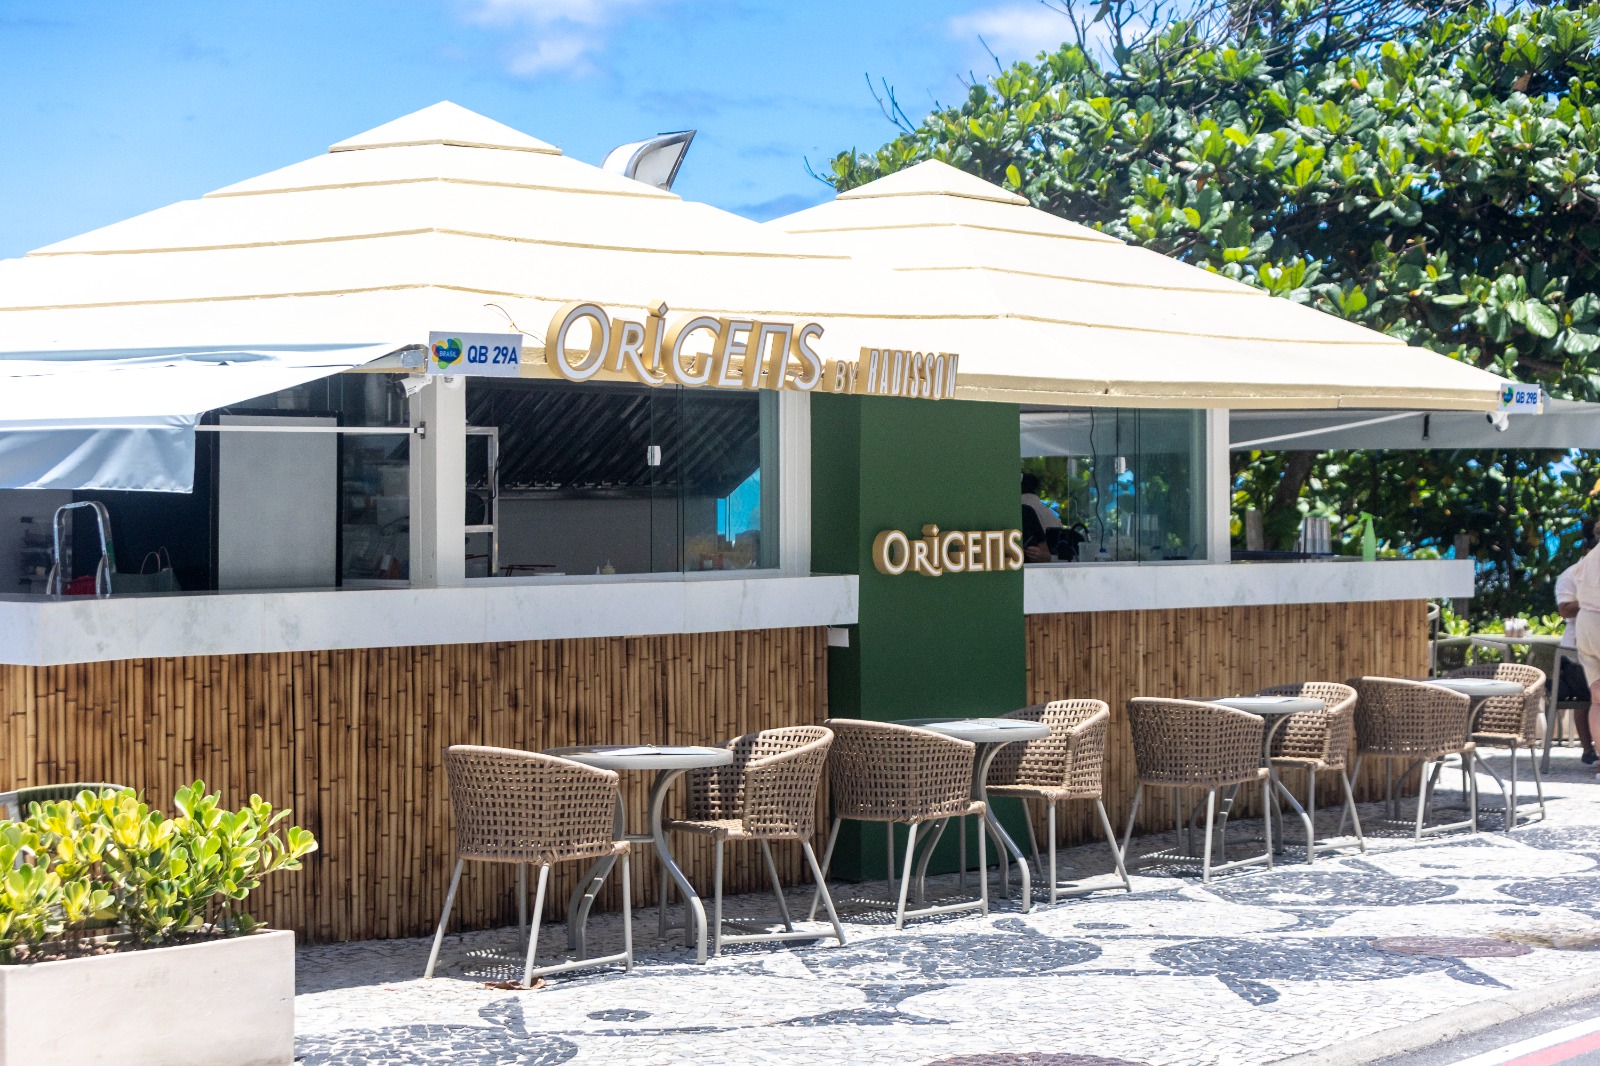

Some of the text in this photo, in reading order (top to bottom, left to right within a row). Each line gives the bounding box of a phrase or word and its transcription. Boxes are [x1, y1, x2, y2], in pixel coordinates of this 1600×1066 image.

[439, 350, 457, 358] BRASIL
[467, 345, 518, 364] QB 29A
[833, 359, 859, 393] BY
[865, 349, 960, 400] RADISSON
[1515, 391, 1525, 404] QB
